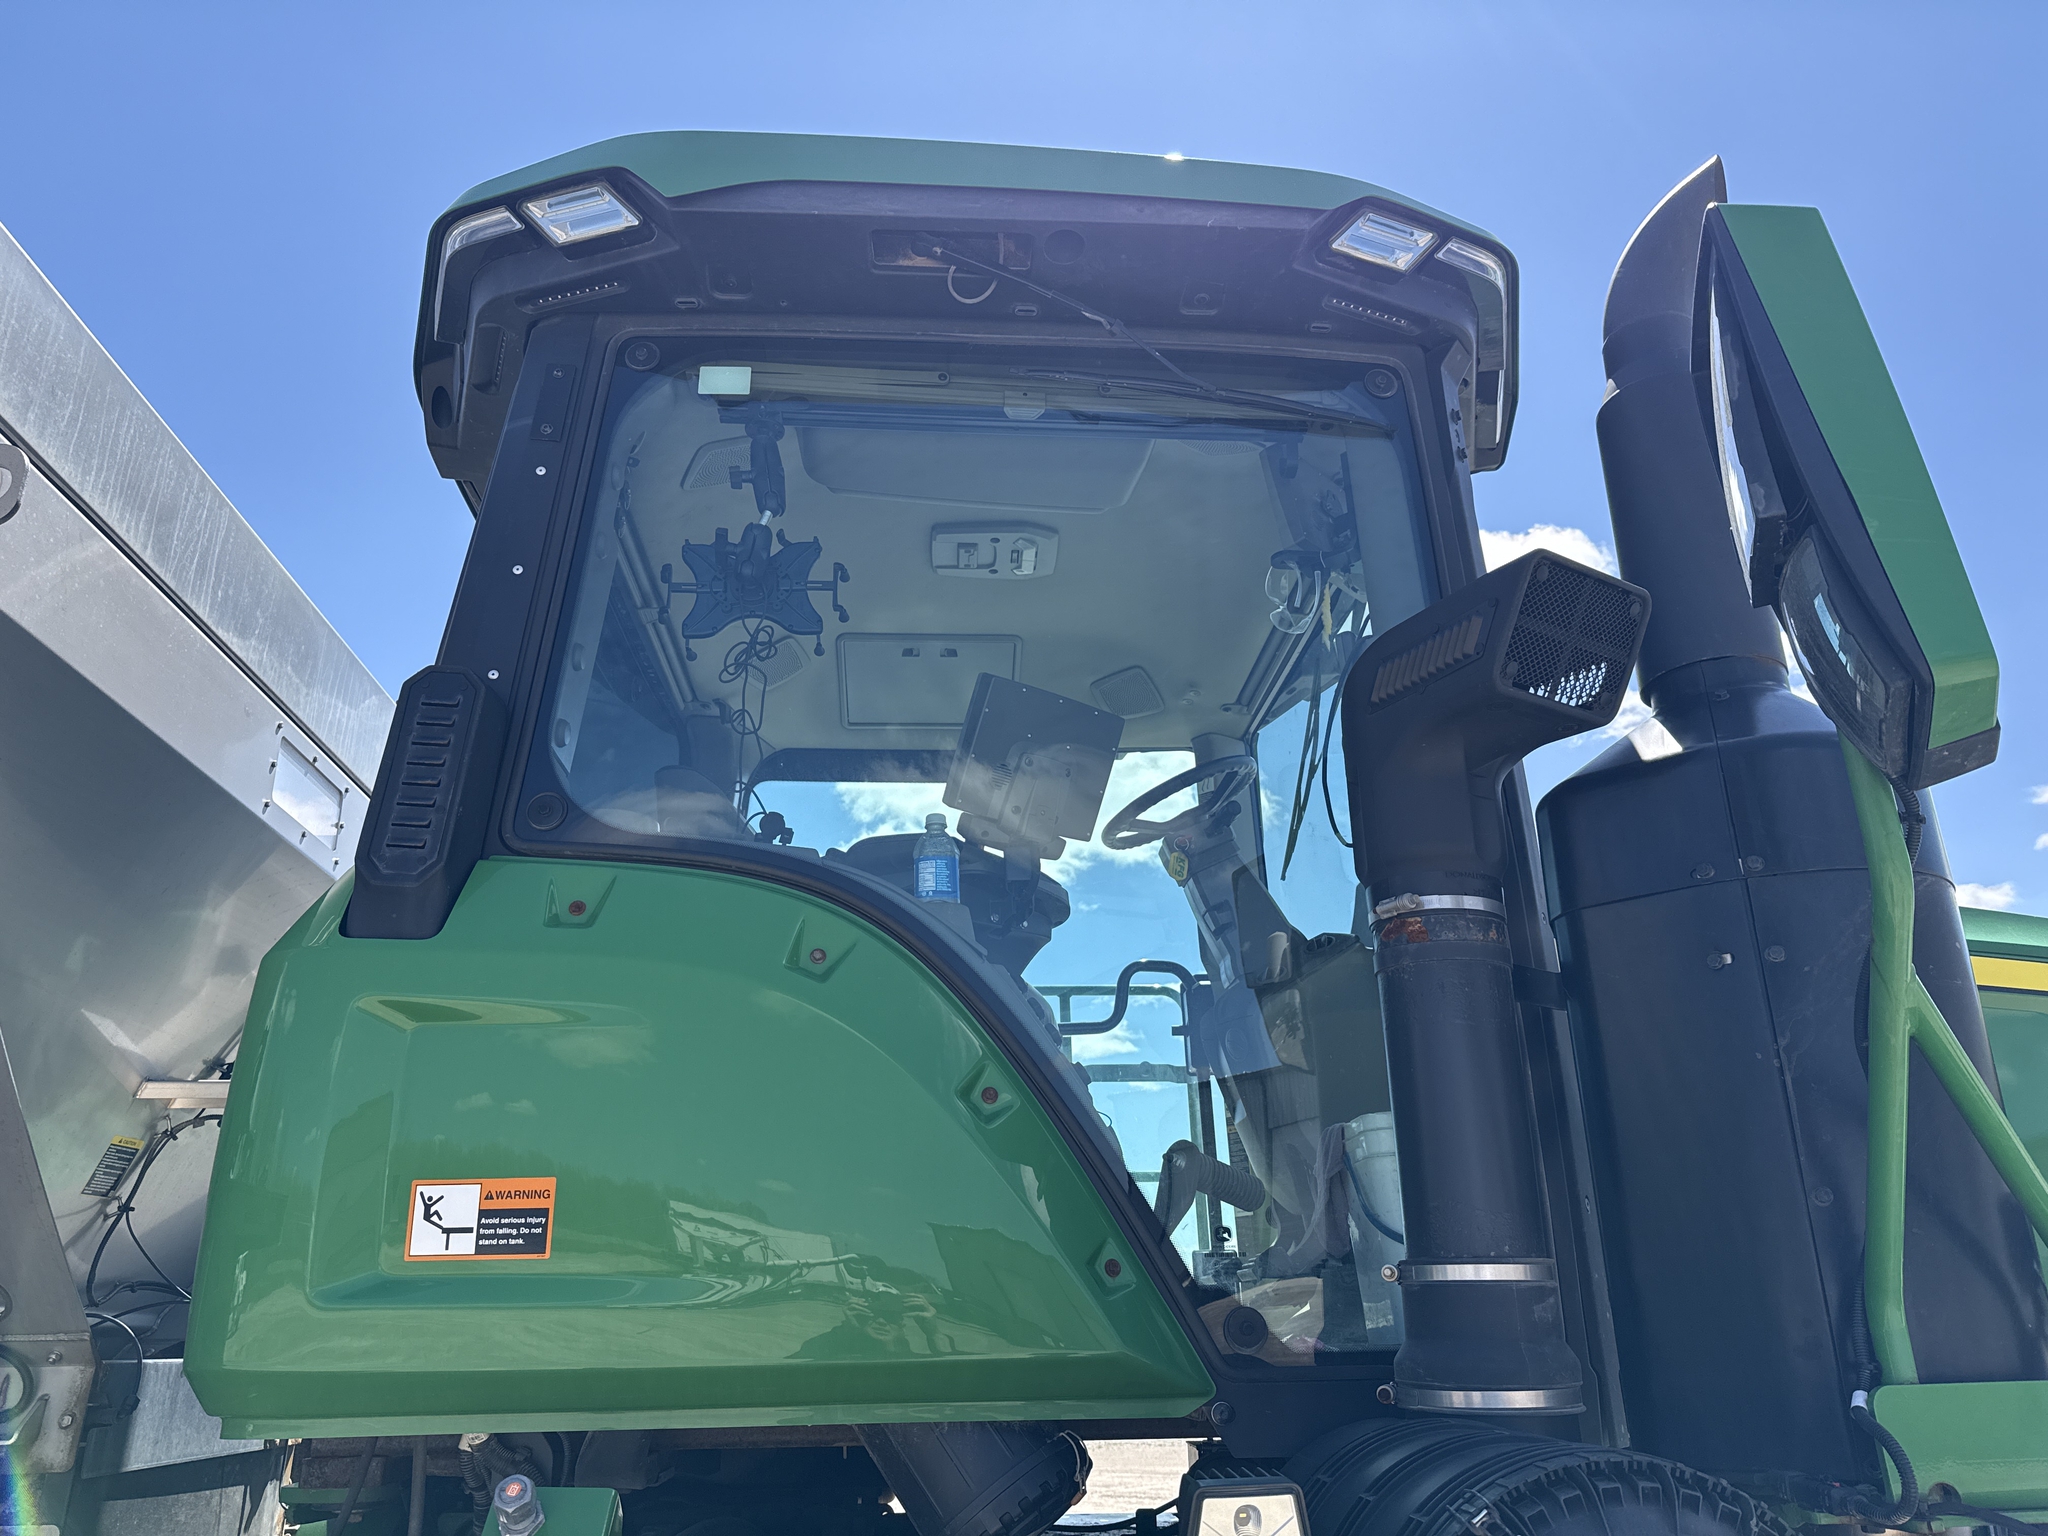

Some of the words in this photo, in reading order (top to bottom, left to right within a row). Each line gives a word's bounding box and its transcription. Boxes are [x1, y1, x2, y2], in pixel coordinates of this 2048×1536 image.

[495, 1189, 551, 1200] WARNING
[480, 1216, 500, 1224] Avoid
[500, 1216, 525, 1224] serious
[526, 1216, 547, 1225] injury
[479, 1227, 495, 1235] from
[496, 1227, 519, 1236] falling.
[508, 1237, 525, 1245] tank.
